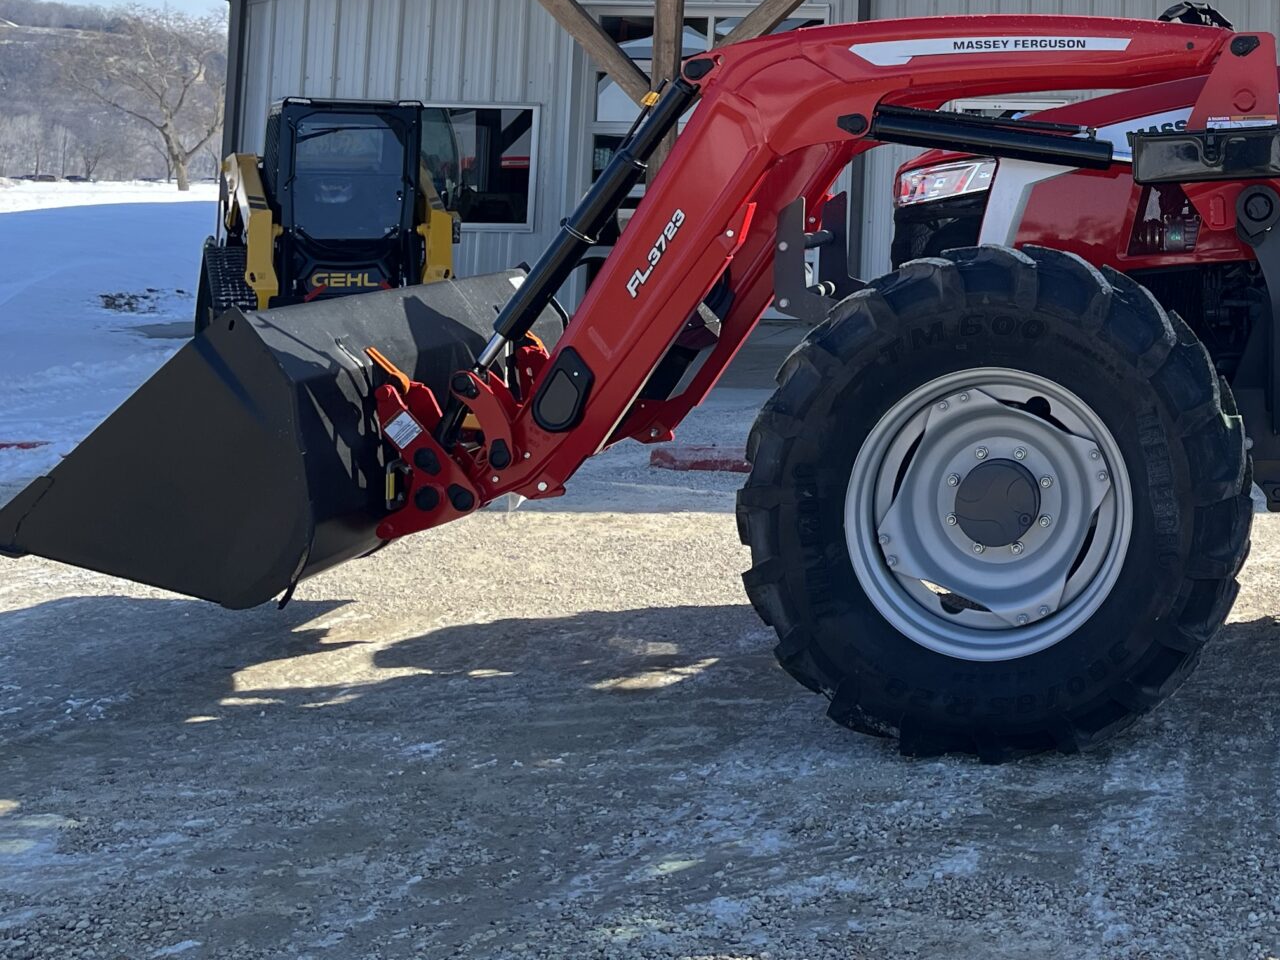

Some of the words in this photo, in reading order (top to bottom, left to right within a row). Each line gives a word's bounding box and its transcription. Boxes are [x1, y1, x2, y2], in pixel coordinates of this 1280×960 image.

[953, 39, 1009, 51] MASSEY
[1013, 39, 1086, 50] FERGUSON
[311, 271, 379, 288] GEHL
